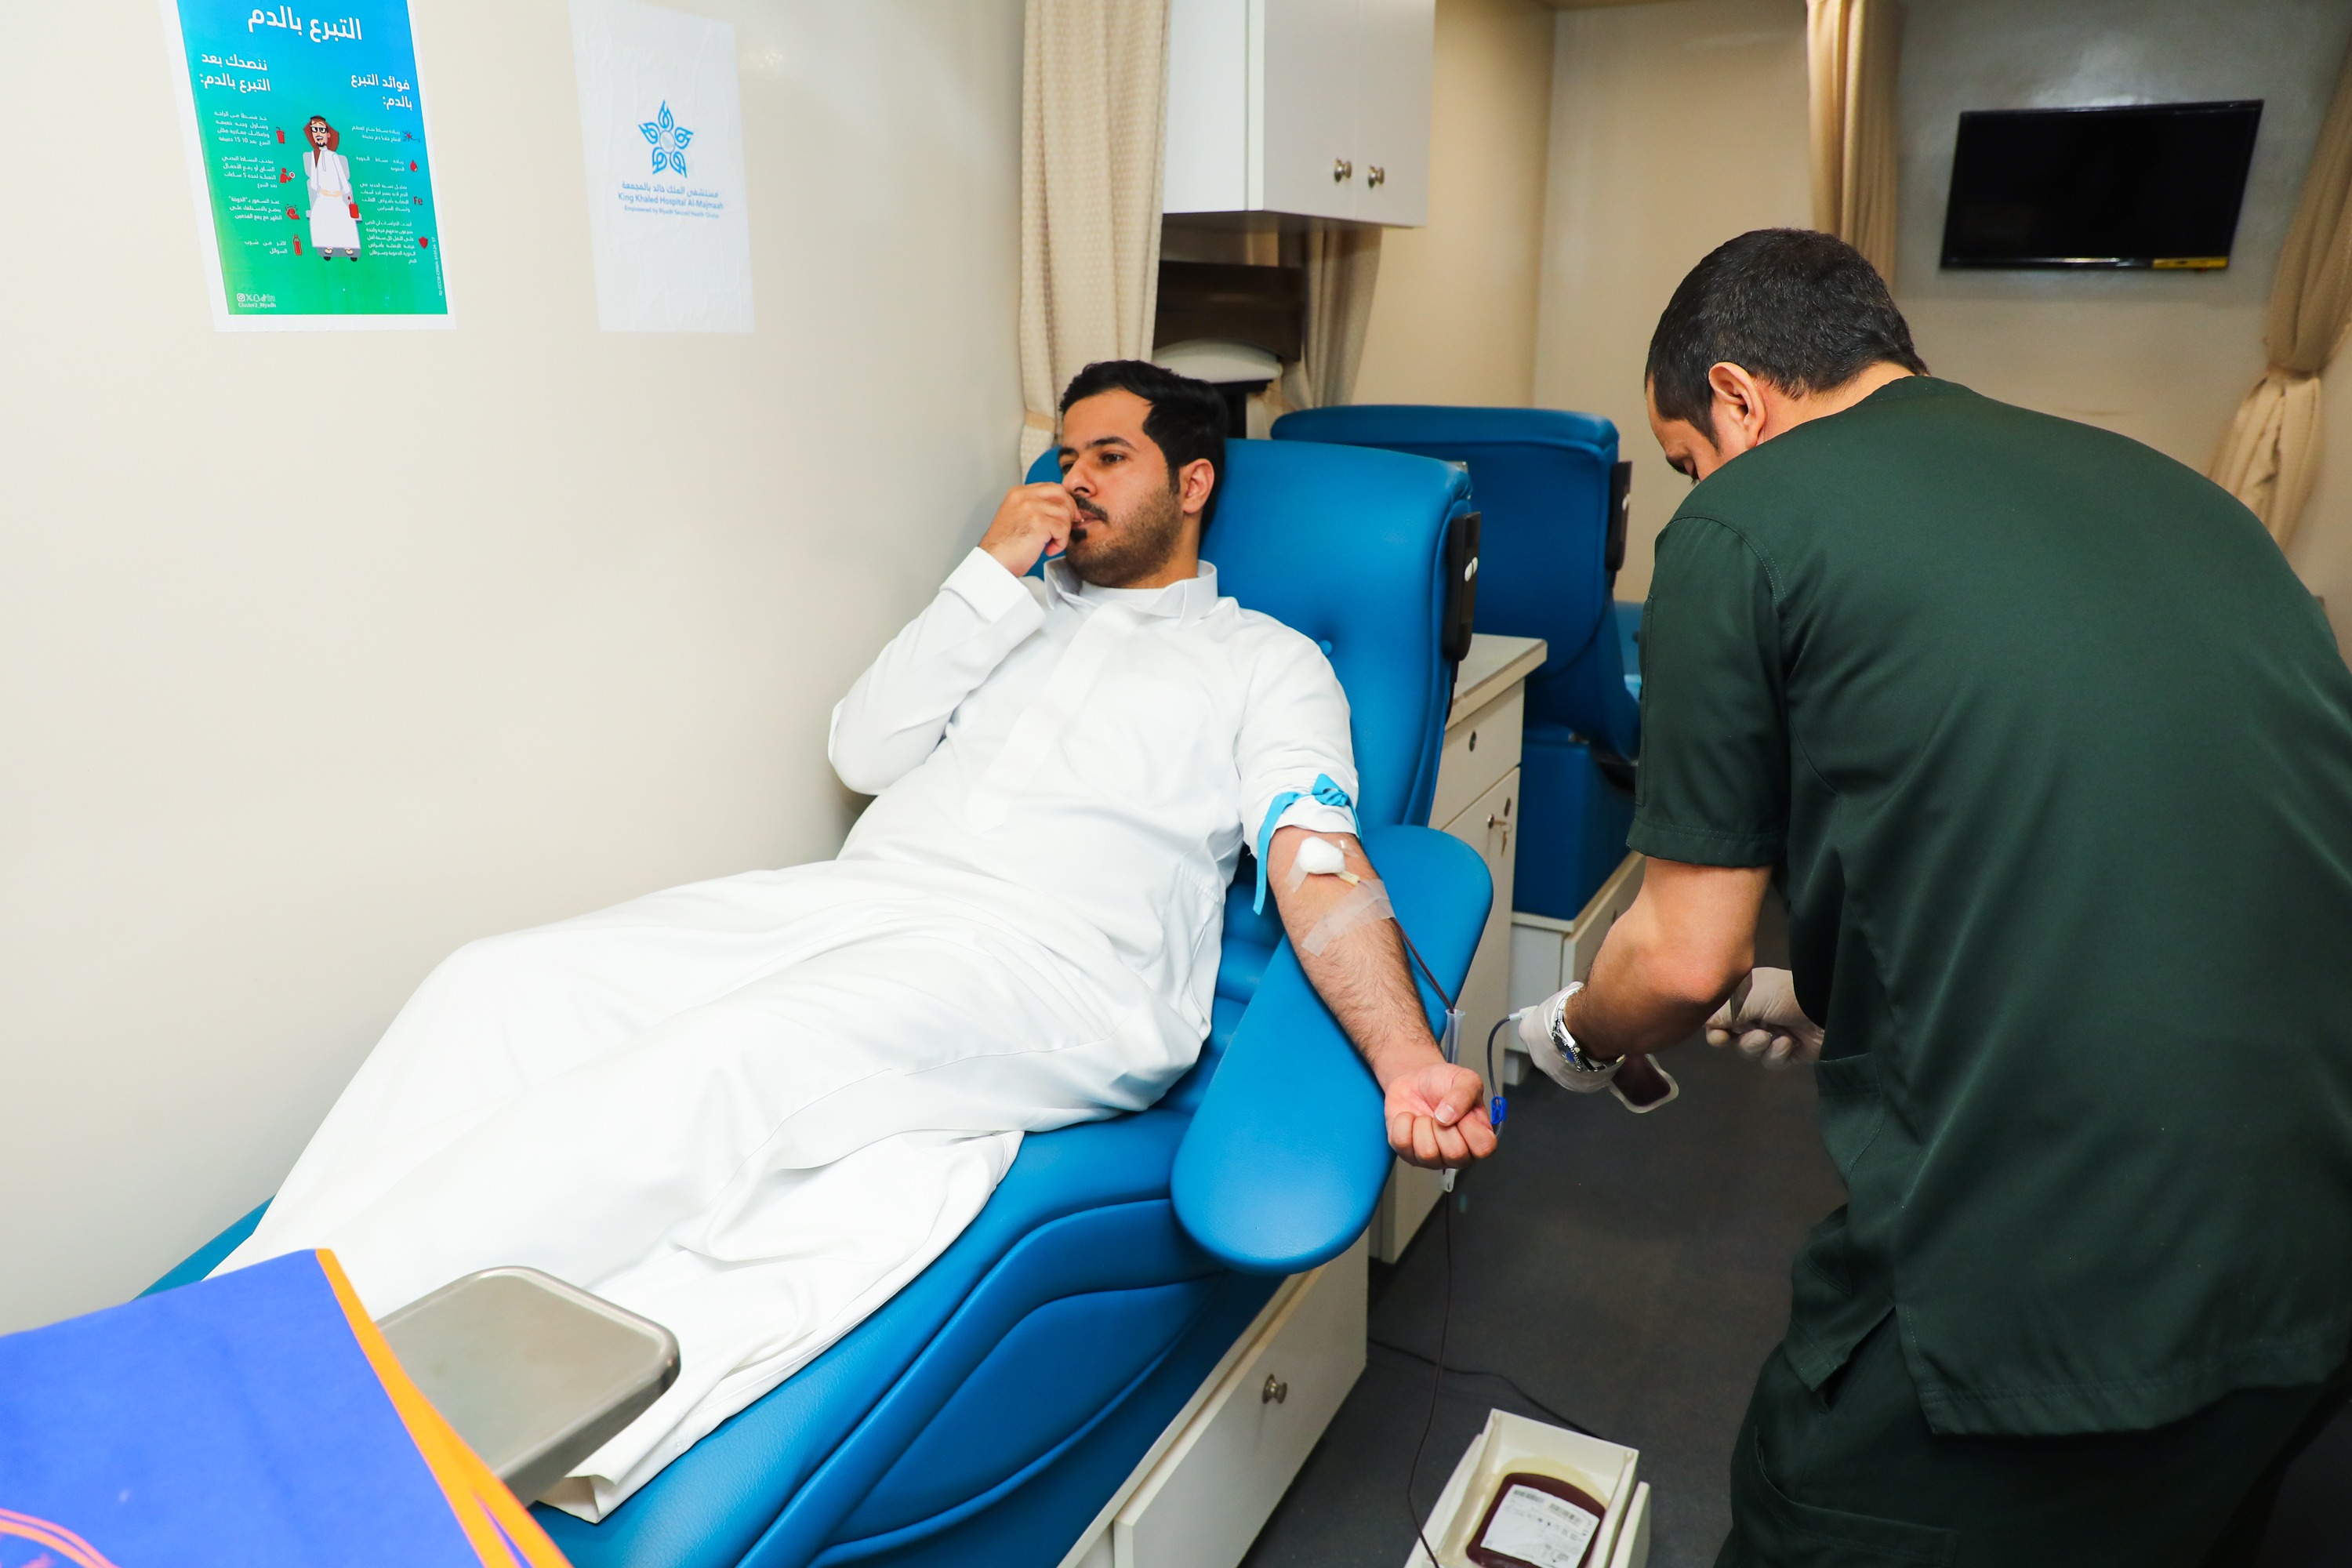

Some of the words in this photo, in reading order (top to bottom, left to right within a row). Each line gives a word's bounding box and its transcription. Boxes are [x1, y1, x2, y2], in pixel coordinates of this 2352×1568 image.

[248, 5, 302, 34] بالدم
[310, 17, 362, 43] التبرع
[201, 52, 222, 67] بعد
[226, 53, 267, 71] ننصحك
[199, 73, 236, 89] بالدم:
[240, 75, 270, 93] التبرع
[351, 74, 378, 88] التبرع
[382, 76, 409, 91] فوائد
[383, 96, 412, 111] بالدم:
[654, 183, 665, 193] خالد
[666, 185, 684, 194] الملك
[413, 196, 423, 205] Fe
[618, 193, 633, 202] King
[636, 194, 658, 203] Khaled
[660, 196, 686, 206] Hospital
